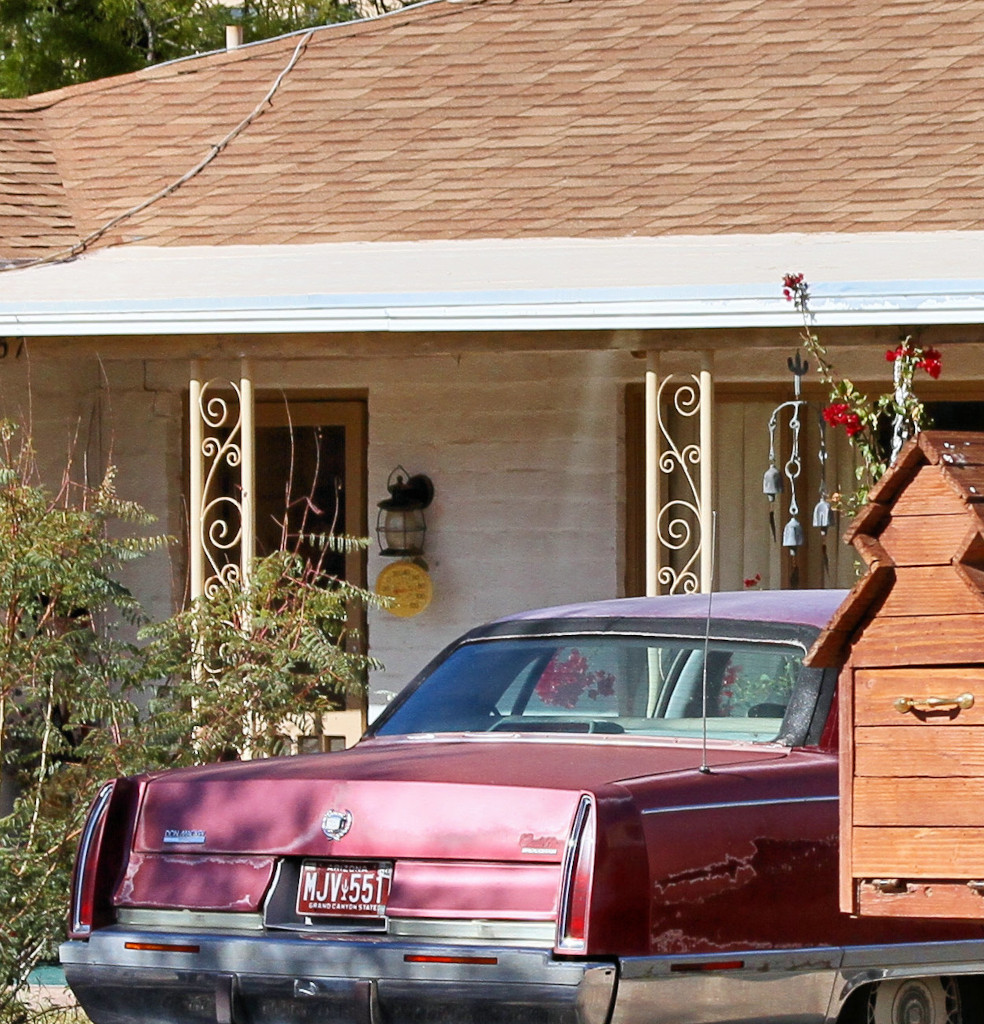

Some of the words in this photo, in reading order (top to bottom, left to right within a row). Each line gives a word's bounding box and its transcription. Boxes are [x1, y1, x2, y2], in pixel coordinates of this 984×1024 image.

[308, 902, 331, 910] GRAND
[332, 903, 358, 911] CANYON
[358, 904, 377, 912] STATE
